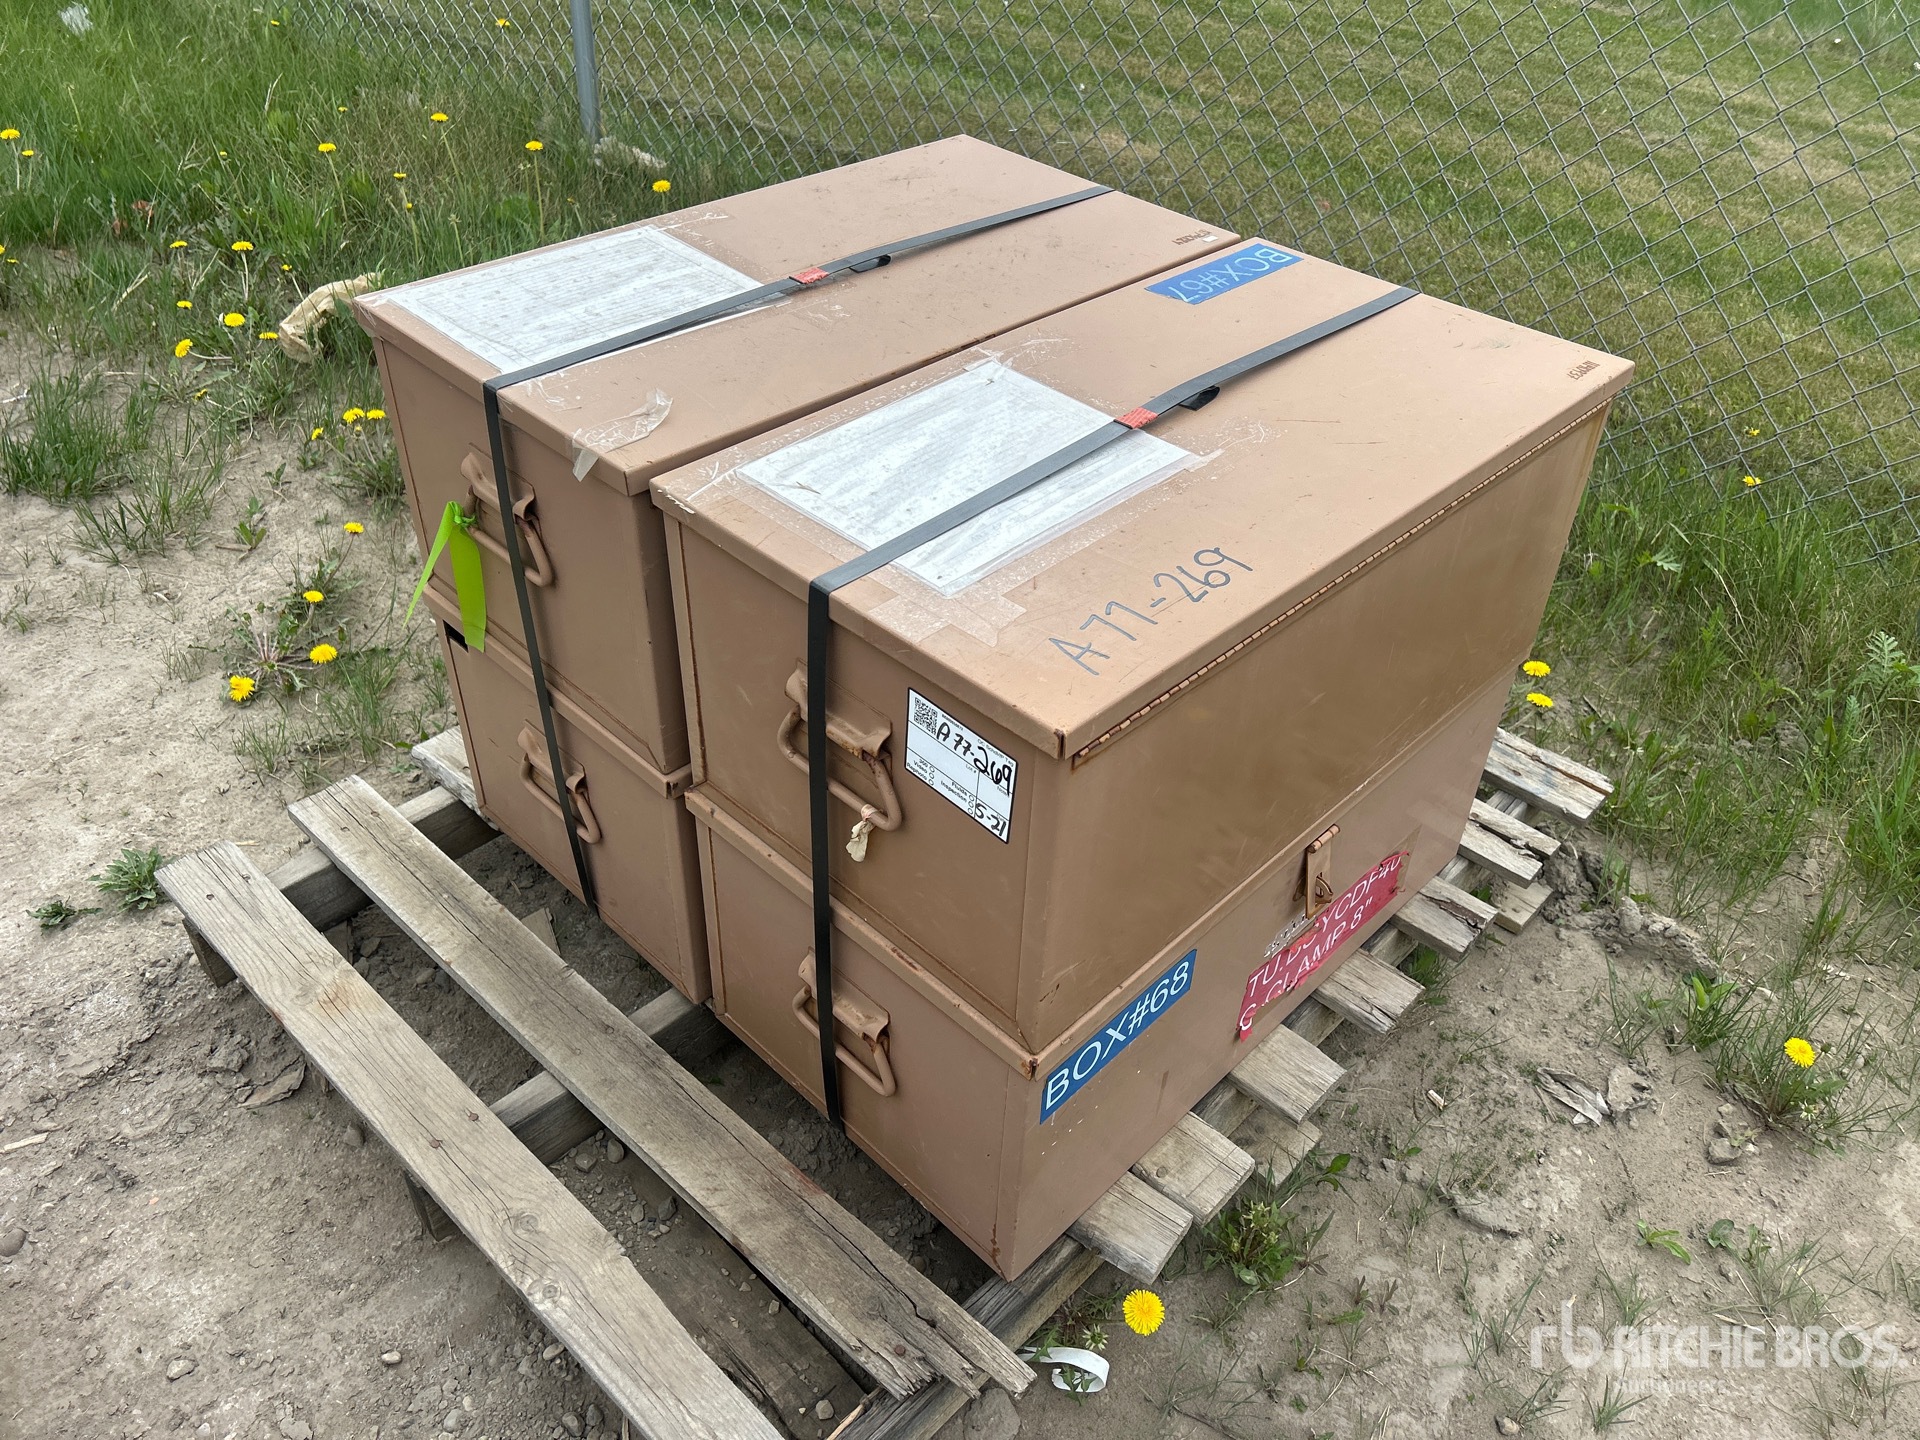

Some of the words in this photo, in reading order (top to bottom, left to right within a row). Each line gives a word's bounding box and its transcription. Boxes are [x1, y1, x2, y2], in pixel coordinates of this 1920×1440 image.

[1167, 247, 1293, 303] BOX#67
[1048, 547, 1254, 676] A77-269
[1044, 960, 1191, 1111] BOX#68
